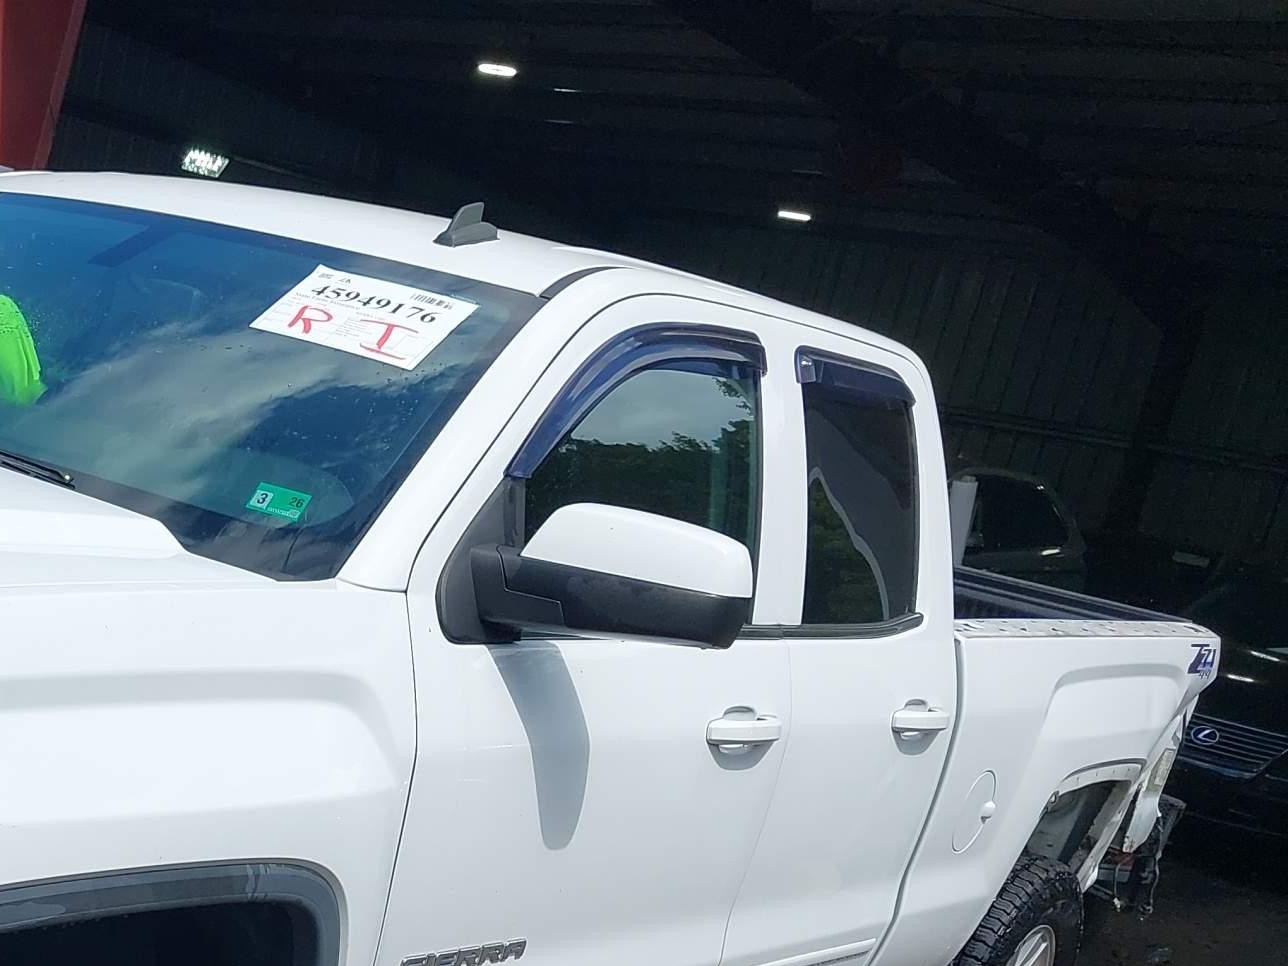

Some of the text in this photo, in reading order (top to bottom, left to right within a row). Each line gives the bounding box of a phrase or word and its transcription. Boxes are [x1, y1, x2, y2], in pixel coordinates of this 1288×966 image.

[288, 305, 333, 334] R
[311, 285, 440, 324] 45949176
[256, 493, 305, 508] 3 26
[1187, 643, 1217, 674] Z71
